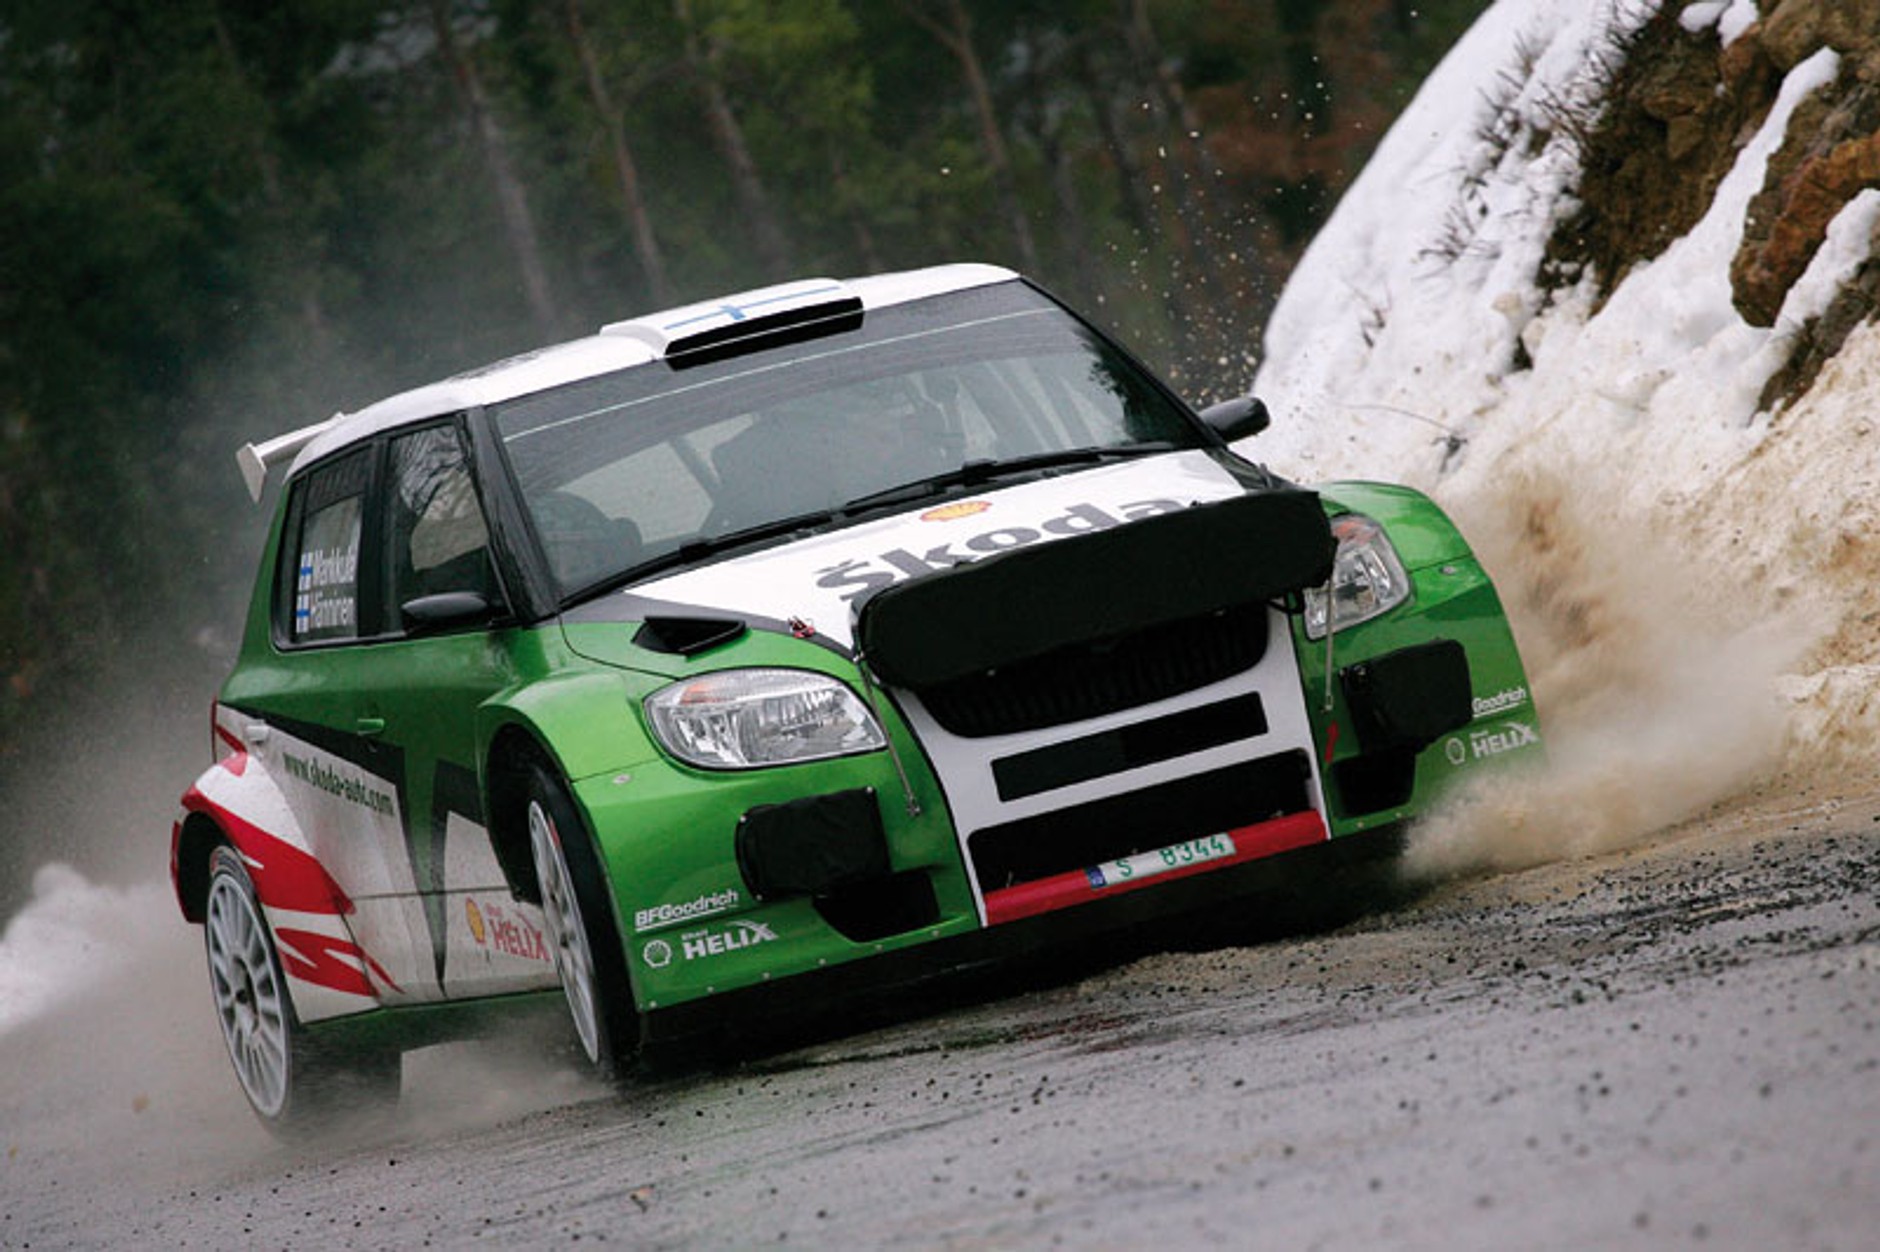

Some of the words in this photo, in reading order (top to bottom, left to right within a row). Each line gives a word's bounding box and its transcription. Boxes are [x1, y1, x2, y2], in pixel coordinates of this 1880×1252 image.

[1471, 723, 1539, 758] HELIX
[1116, 859, 1132, 878] S
[1159, 835, 1224, 866] 8344
[634, 889, 739, 928] BFGoodrich
[682, 920, 779, 960] HELIX
